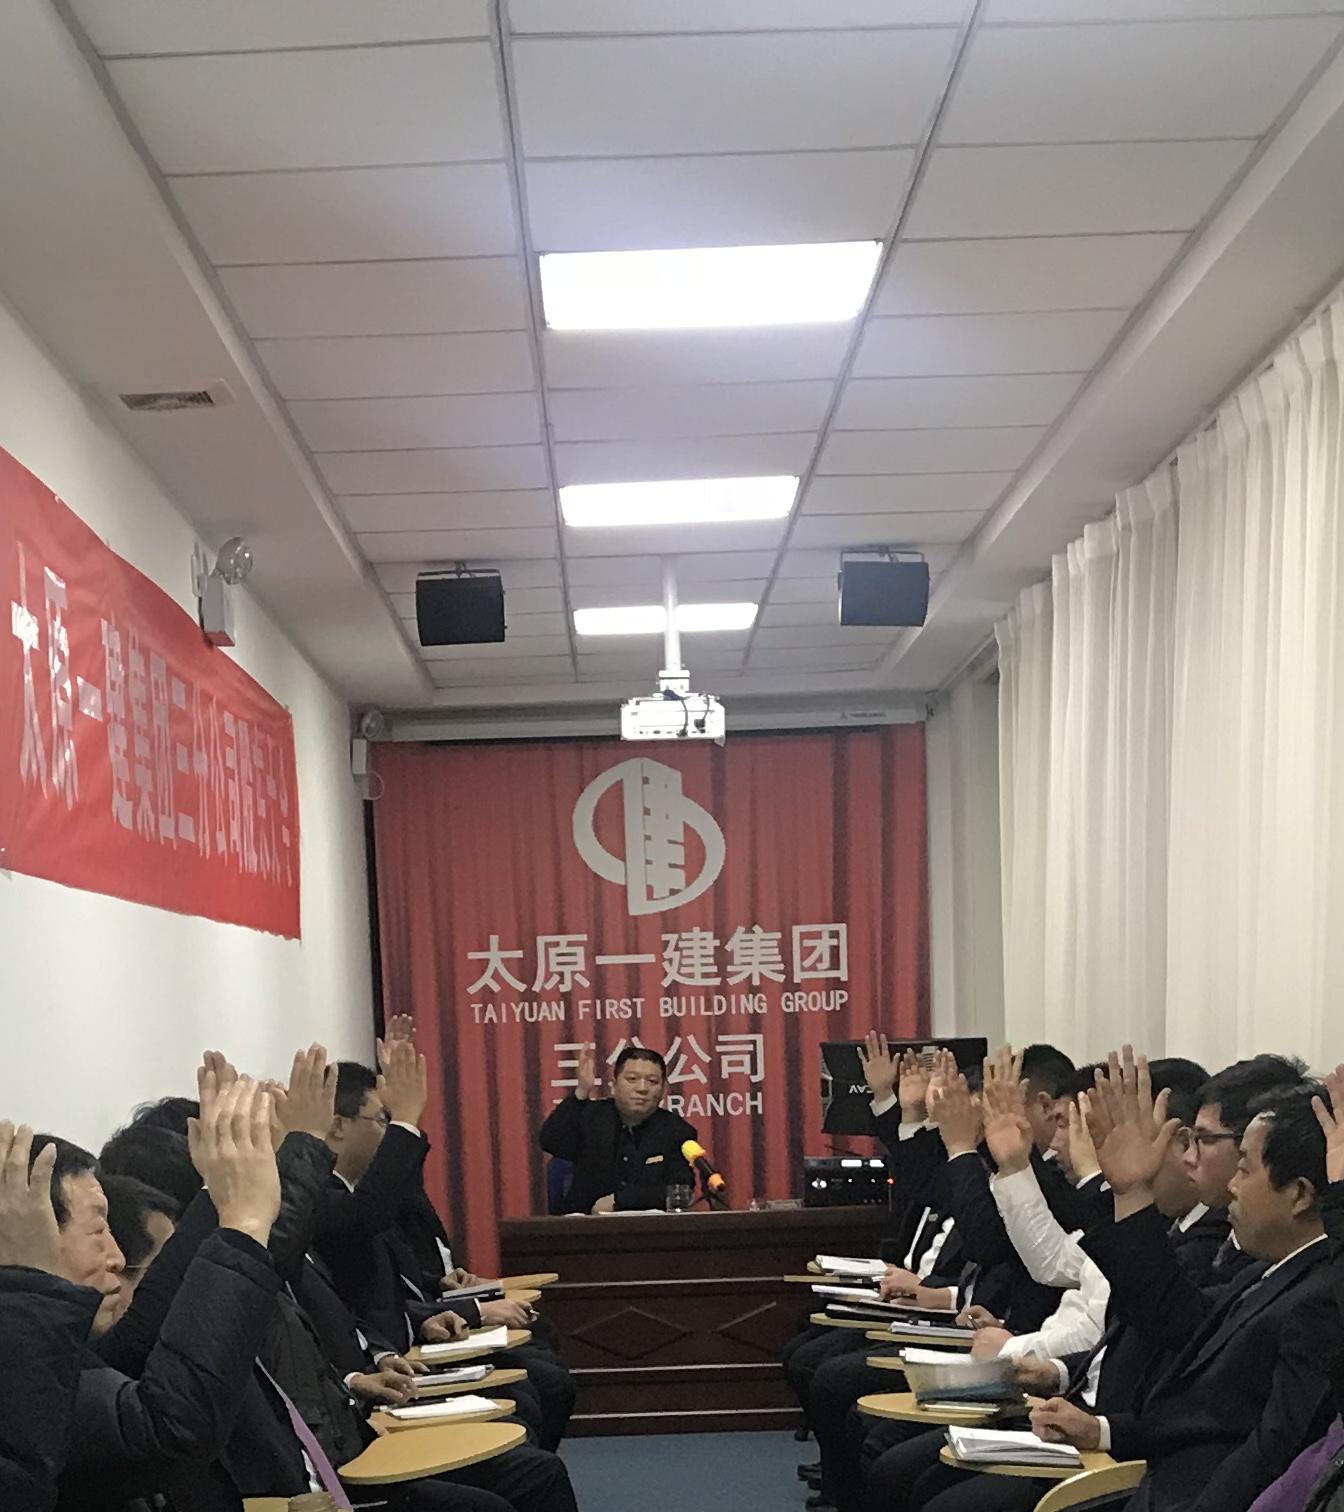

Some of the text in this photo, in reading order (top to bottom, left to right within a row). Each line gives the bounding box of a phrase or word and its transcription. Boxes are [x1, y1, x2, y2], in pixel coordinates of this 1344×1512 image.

[466, 923, 849, 996] 太原一建集团
[471, 990, 849, 1024] TAIYUAN FIRST BUILDING GROUP
[659, 1091, 763, 1118] RANCH
